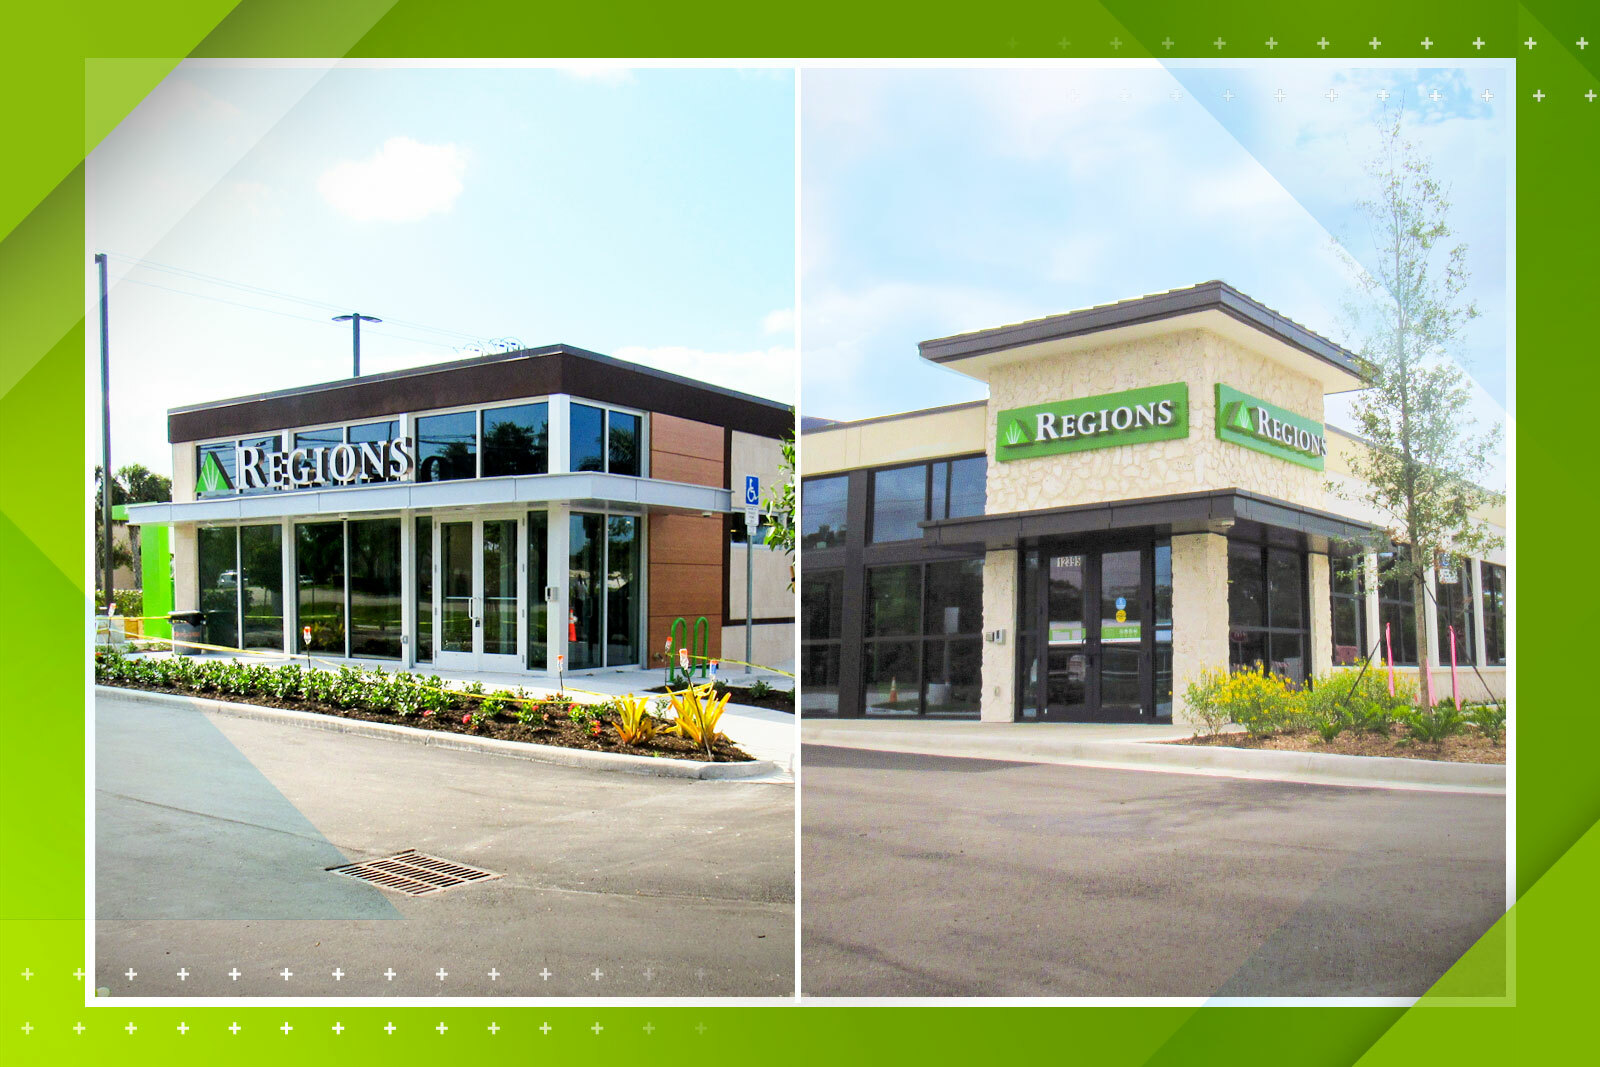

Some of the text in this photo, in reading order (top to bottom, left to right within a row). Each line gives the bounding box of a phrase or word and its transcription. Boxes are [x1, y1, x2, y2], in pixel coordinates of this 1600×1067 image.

[1035, 400, 1173, 441] REGIONS
[1256, 406, 1327, 457] REGIONS
[235, 437, 413, 489] REGIONS
